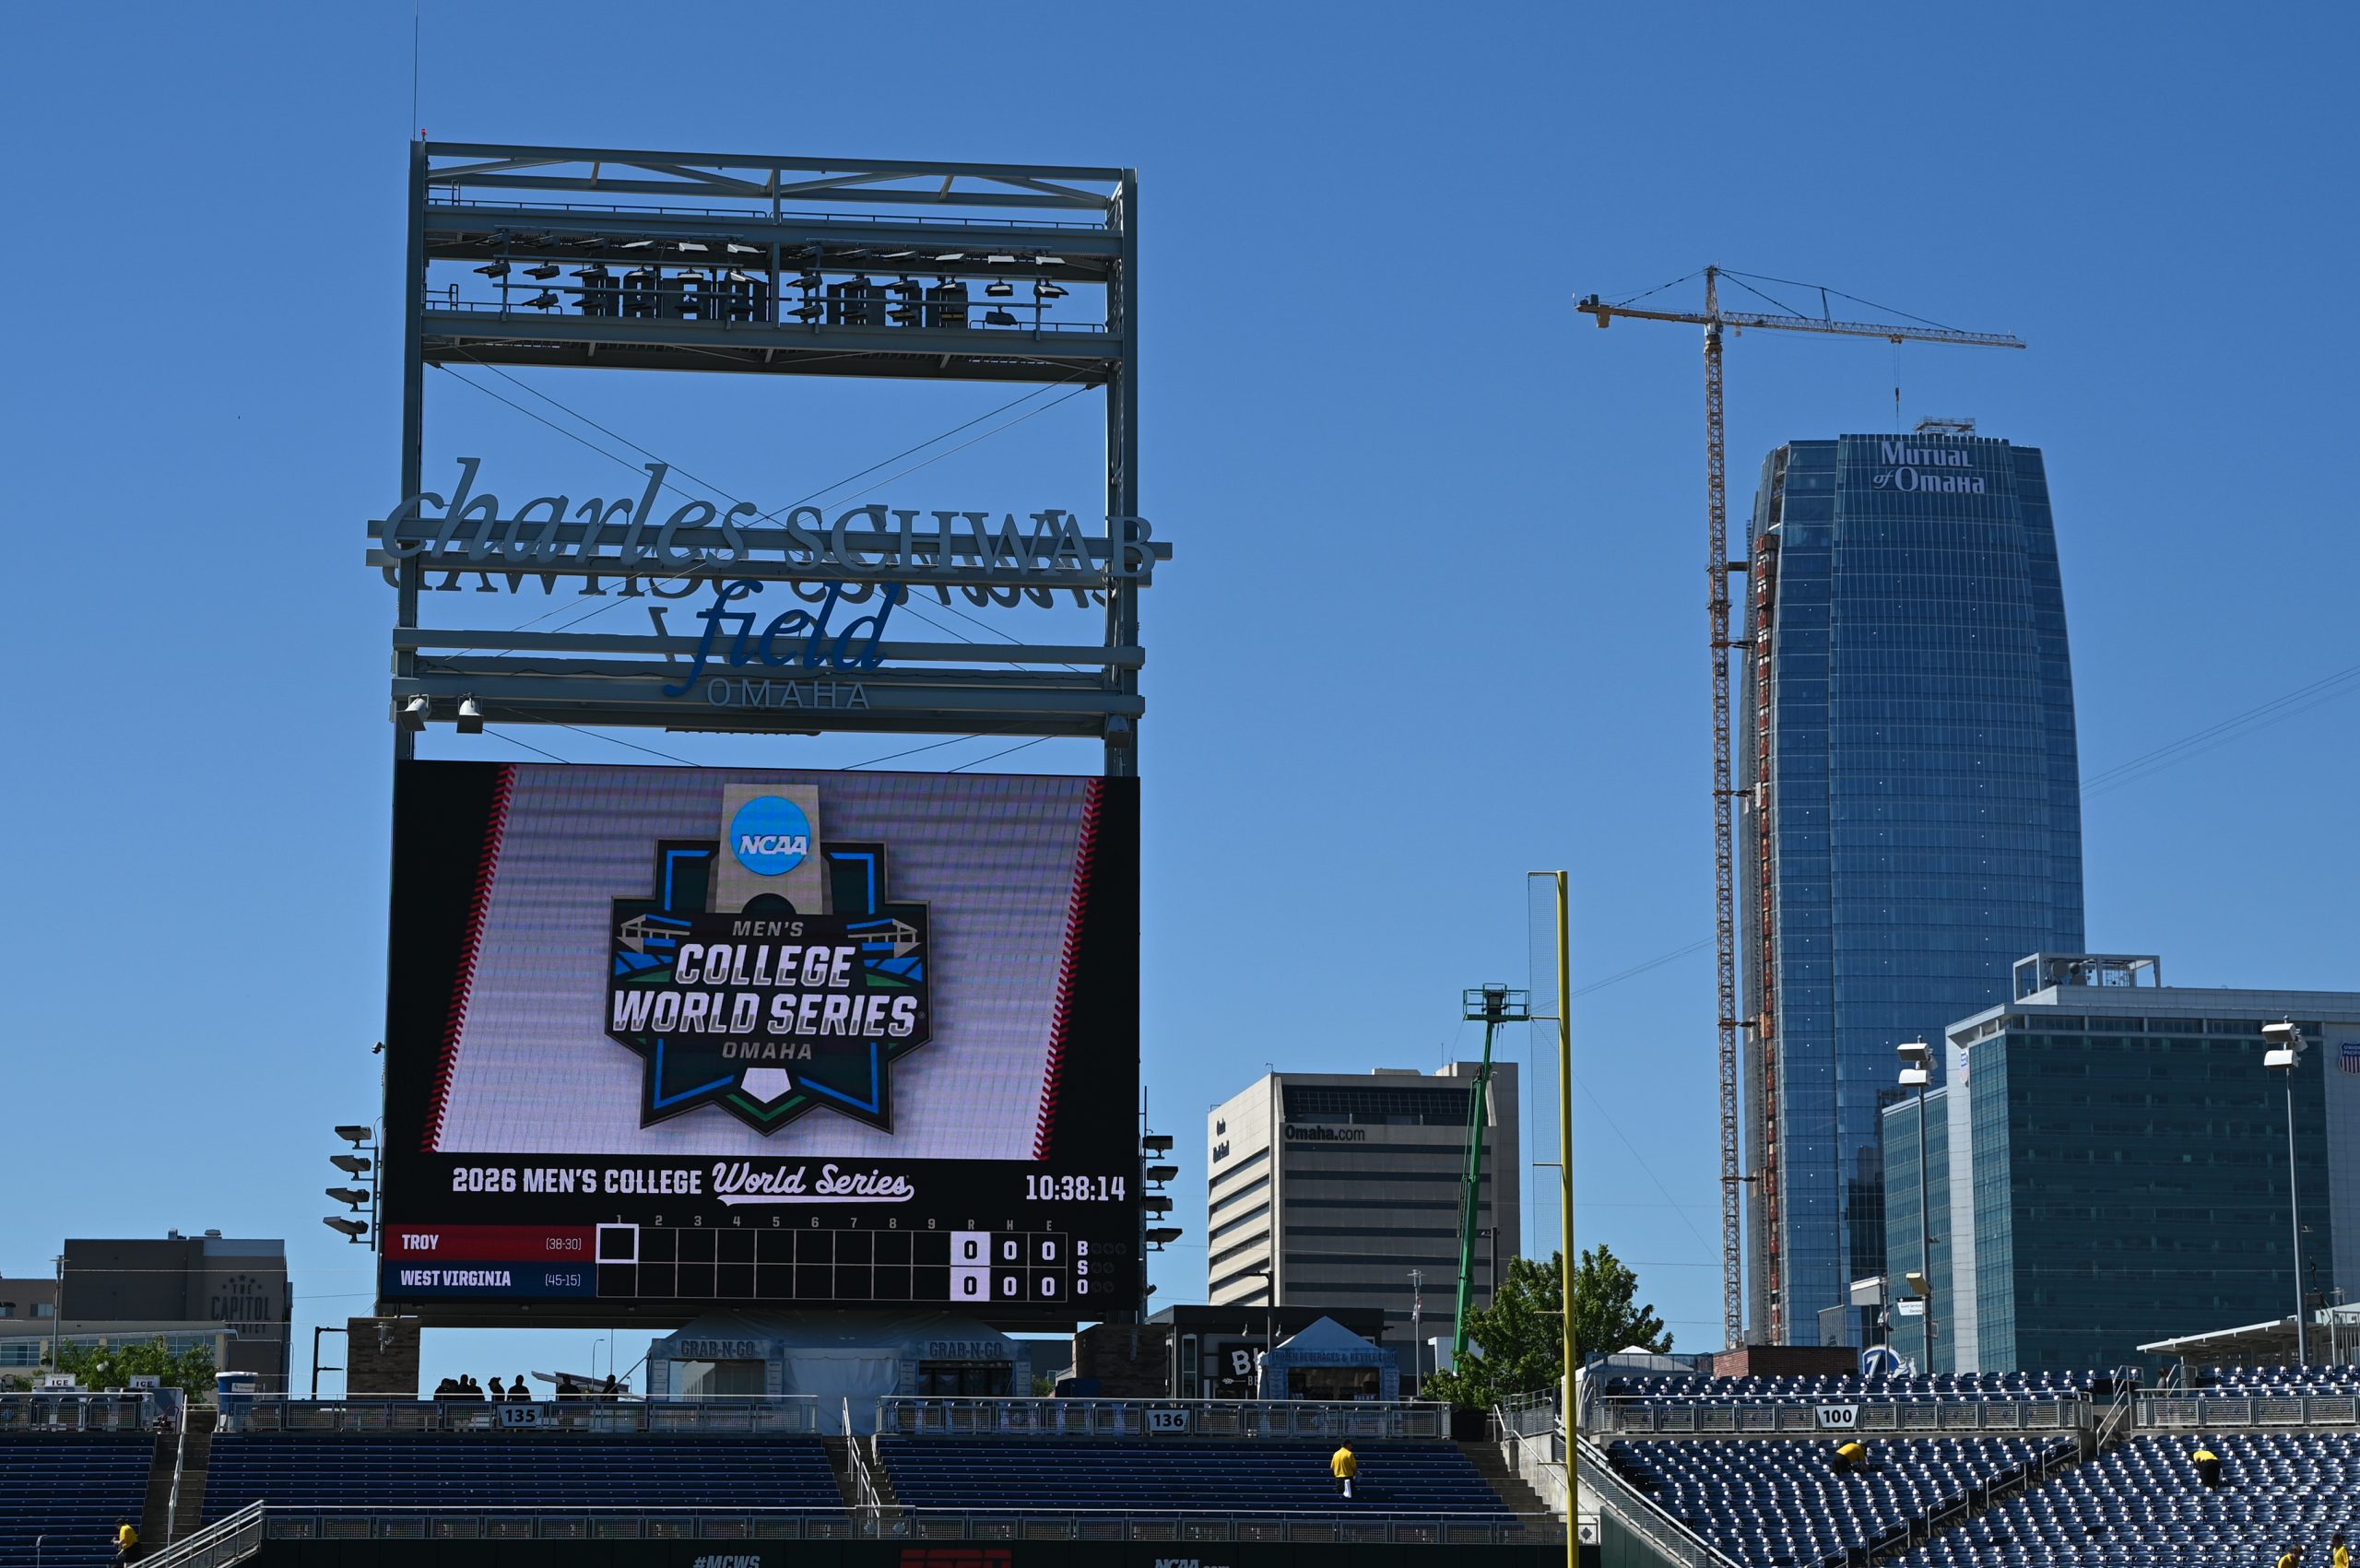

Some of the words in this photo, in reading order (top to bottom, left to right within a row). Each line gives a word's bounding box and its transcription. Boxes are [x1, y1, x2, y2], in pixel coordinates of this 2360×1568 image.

[1873, 469, 1894, 489] of
[381, 457, 757, 569] charles
[784, 506, 1156, 578] SCHWAB
[663, 579, 902, 697] field
[707, 678, 870, 709] OMAHA
[738, 834, 808, 855] NCAA
[732, 920, 804, 937] MEN'S
[675, 943, 856, 988] COLLEGE
[612, 990, 761, 1035] WORLD
[766, 993, 918, 1037] SERIES
[722, 1041, 812, 1060] OMAHA
[1285, 1125, 1365, 1141] Omaha.com
[452, 1167, 516, 1192] 2026
[523, 1168, 596, 1193] MEN'S
[604, 1169, 702, 1194] COLLEGE
[712, 1161, 807, 1194] World
[815, 1163, 914, 1197] Series
[1026, 1174, 1125, 1201] 10:38:14
[617, 1215, 621, 1224] 1
[655, 1216, 663, 1226] 2
[694, 1216, 702, 1226] 3
[733, 1216, 741, 1227] 4
[773, 1217, 780, 1227] 5
[811, 1217, 819, 1228] 6
[851, 1218, 857, 1228] 7
[889, 1218, 897, 1229] 8
[927, 1219, 936, 1230] 9
[968, 1219, 975, 1230] R
[1007, 1220, 1013, 1231] H
[1046, 1220, 1053, 1231] E
[402, 1234, 439, 1250] TROY
[546, 1237, 582, 1251] (38-30)
[963, 1240, 978, 1259] 0
[1003, 1241, 1017, 1260] 0
[1042, 1241, 1056, 1260] 0
[1077, 1240, 1089, 1256] B
[1077, 1259, 1089, 1276] S
[232, 1283, 252, 1295] THE
[400, 1269, 441, 1286] WEST
[442, 1270, 512, 1287] VIRGINIA
[545, 1273, 581, 1288] (45-15)
[963, 1276, 977, 1295] 0
[1003, 1276, 1017, 1296] 0
[1042, 1277, 1056, 1297] 0
[211, 1296, 271, 1320] CAPITOL
[680, 1340, 755, 1358] GRAB-N-GO
[929, 1341, 1004, 1359] GRAB-N-GO
[505, 1409, 535, 1422] 135
[1153, 1413, 1184, 1427] 136
[1823, 1409, 1852, 1423] 100
